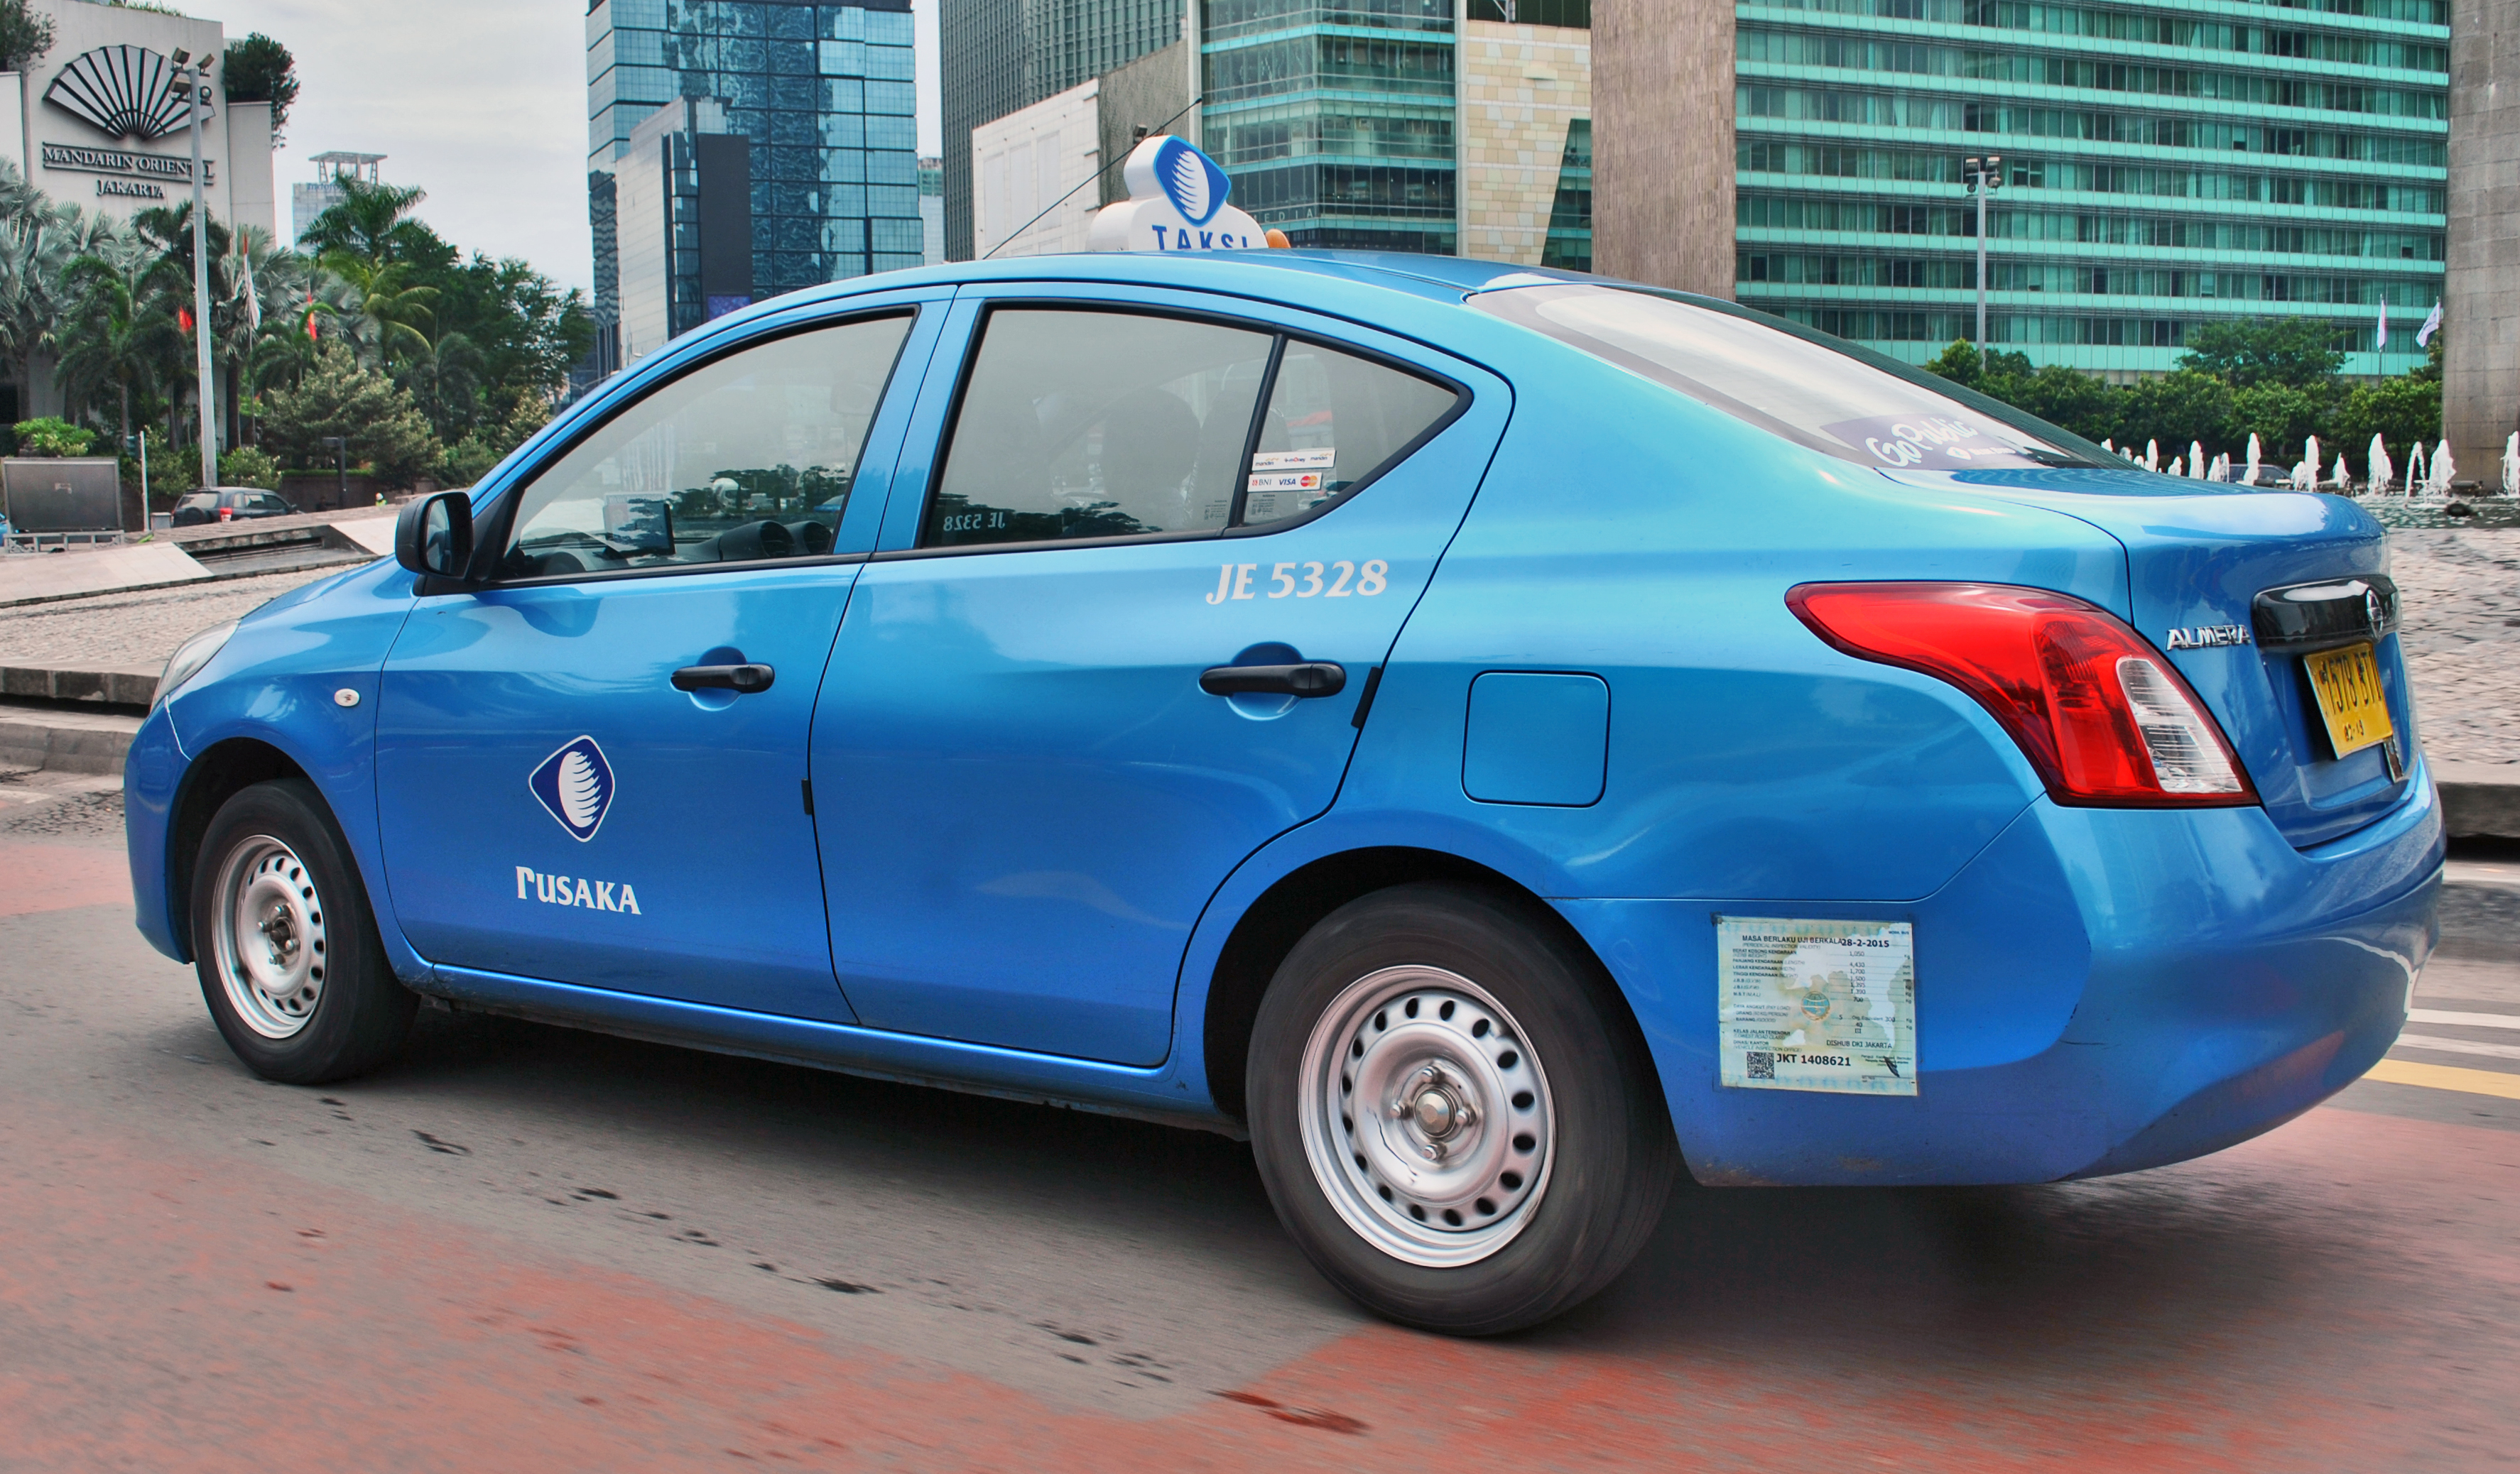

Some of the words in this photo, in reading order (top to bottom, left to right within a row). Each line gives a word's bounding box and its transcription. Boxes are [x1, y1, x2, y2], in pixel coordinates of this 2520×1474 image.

[43, 146, 133, 169] MANDARIN
[136, 157, 215, 178] ORIENTL
[97, 179, 165, 200] JAKARTA
[1151, 225, 1248, 250] TAKSI
[1205, 563, 1257, 605] JE
[1268, 559, 1389, 599] 5328
[2166, 623, 2252, 651] ALMERA
[515, 866, 642, 915] PUSAKA
[1841, 939, 1890, 948] 28-2-2015
[1776, 1053, 1798, 1064] JKT
[1801, 1054, 1851, 1066] 1408621
